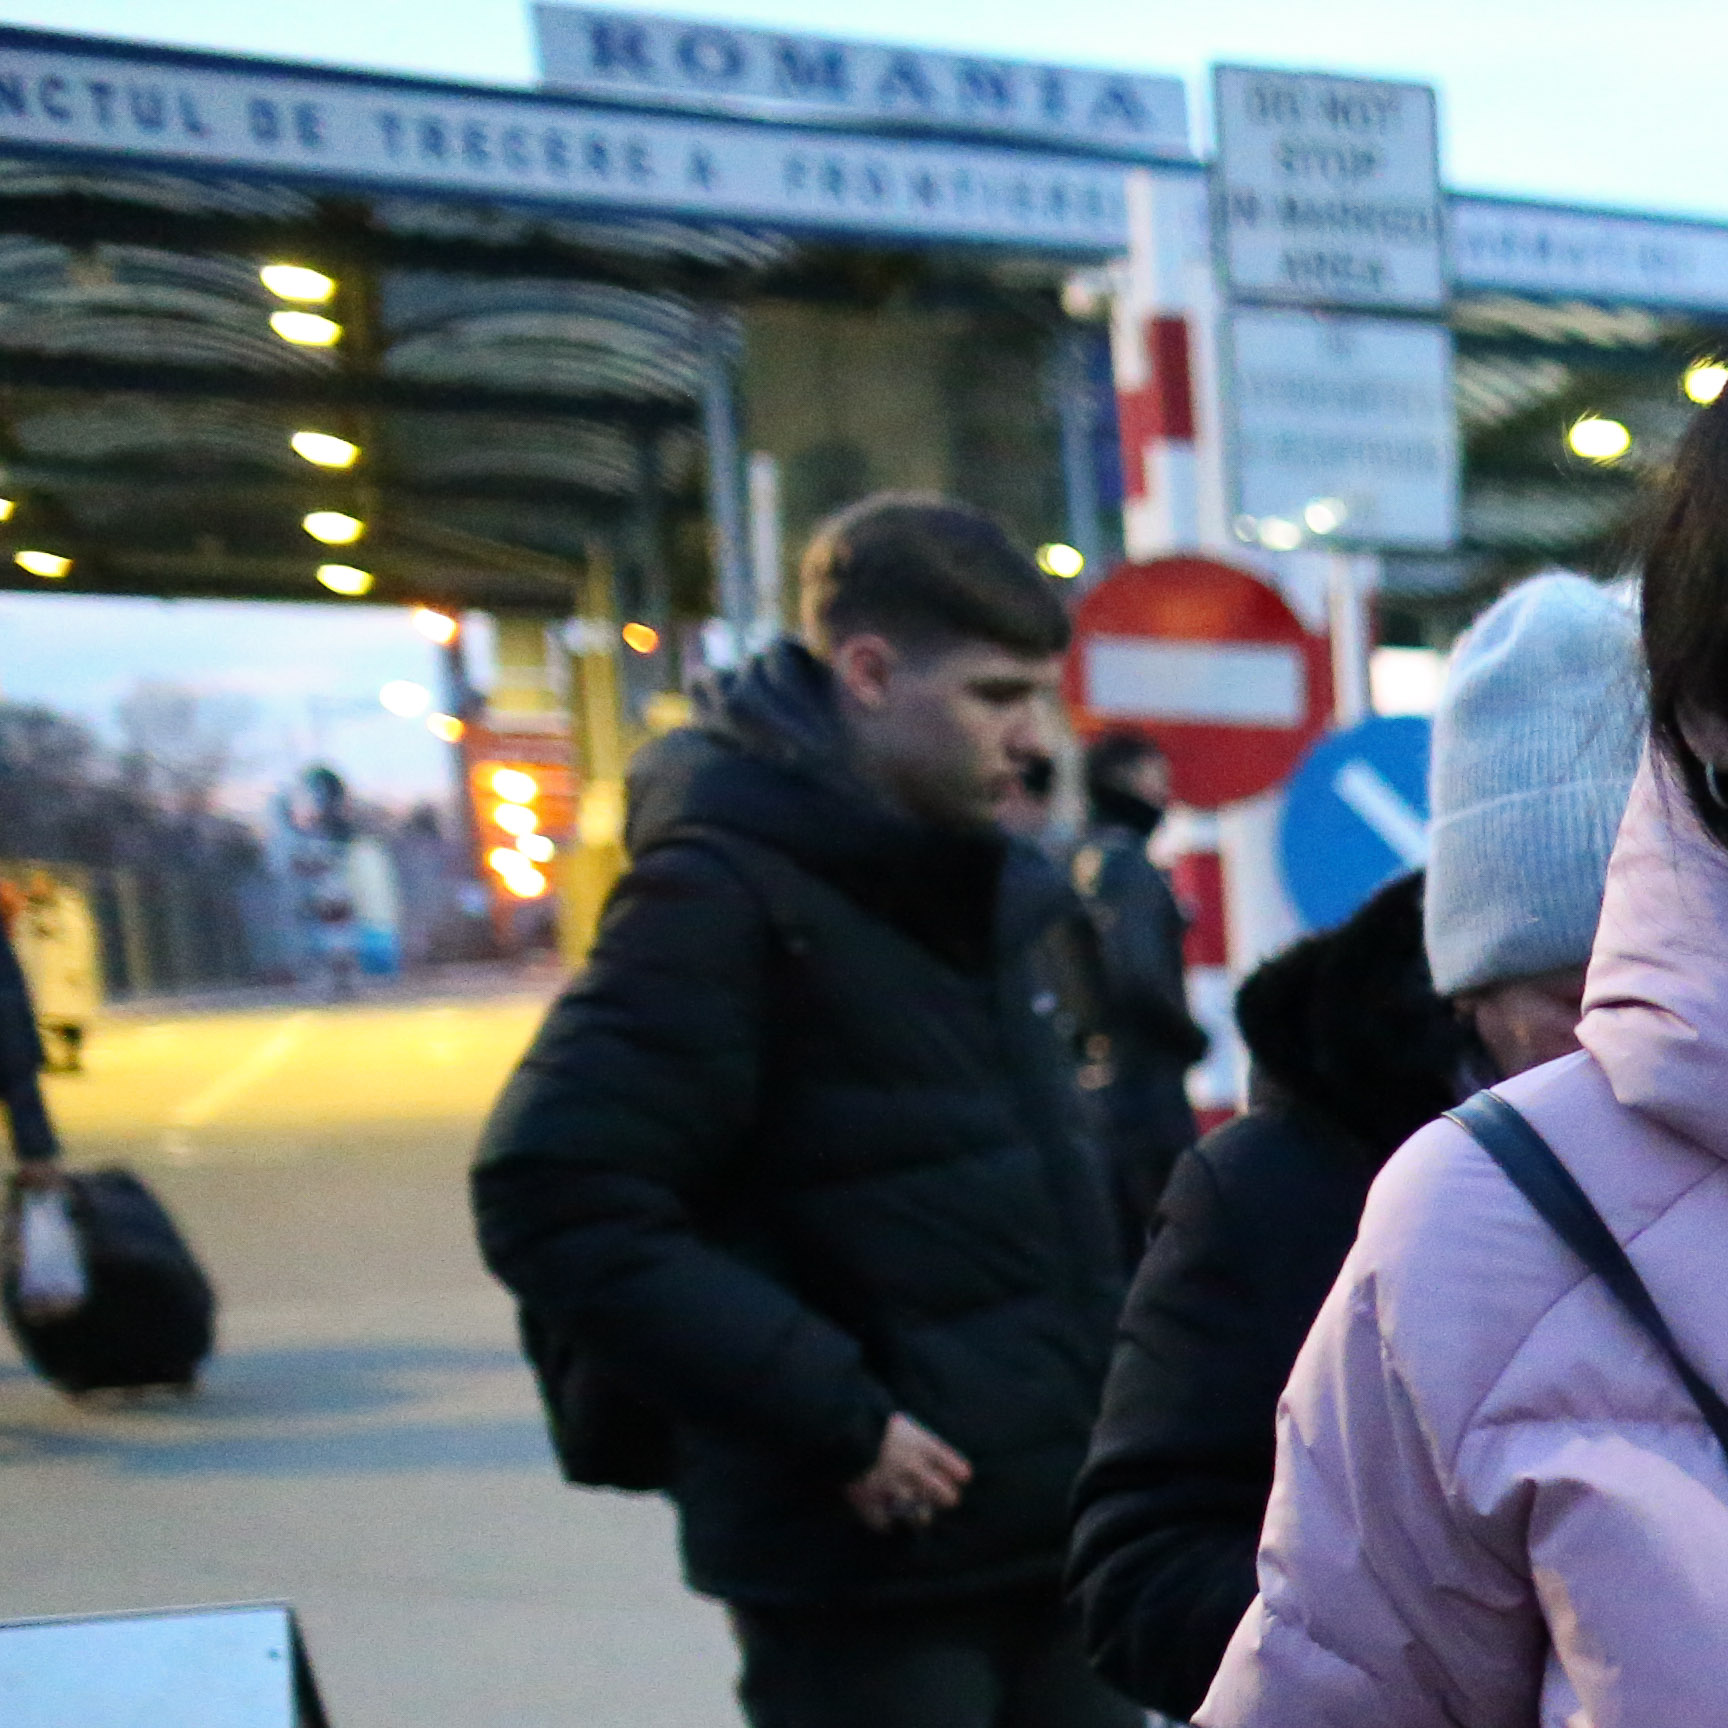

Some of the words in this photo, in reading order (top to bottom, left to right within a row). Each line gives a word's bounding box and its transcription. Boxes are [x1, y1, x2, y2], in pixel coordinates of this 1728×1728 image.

[585, 12, 1150, 132] ROMANIA
[248, 95, 324, 149] DE
[373, 108, 656, 184] TRECERE
